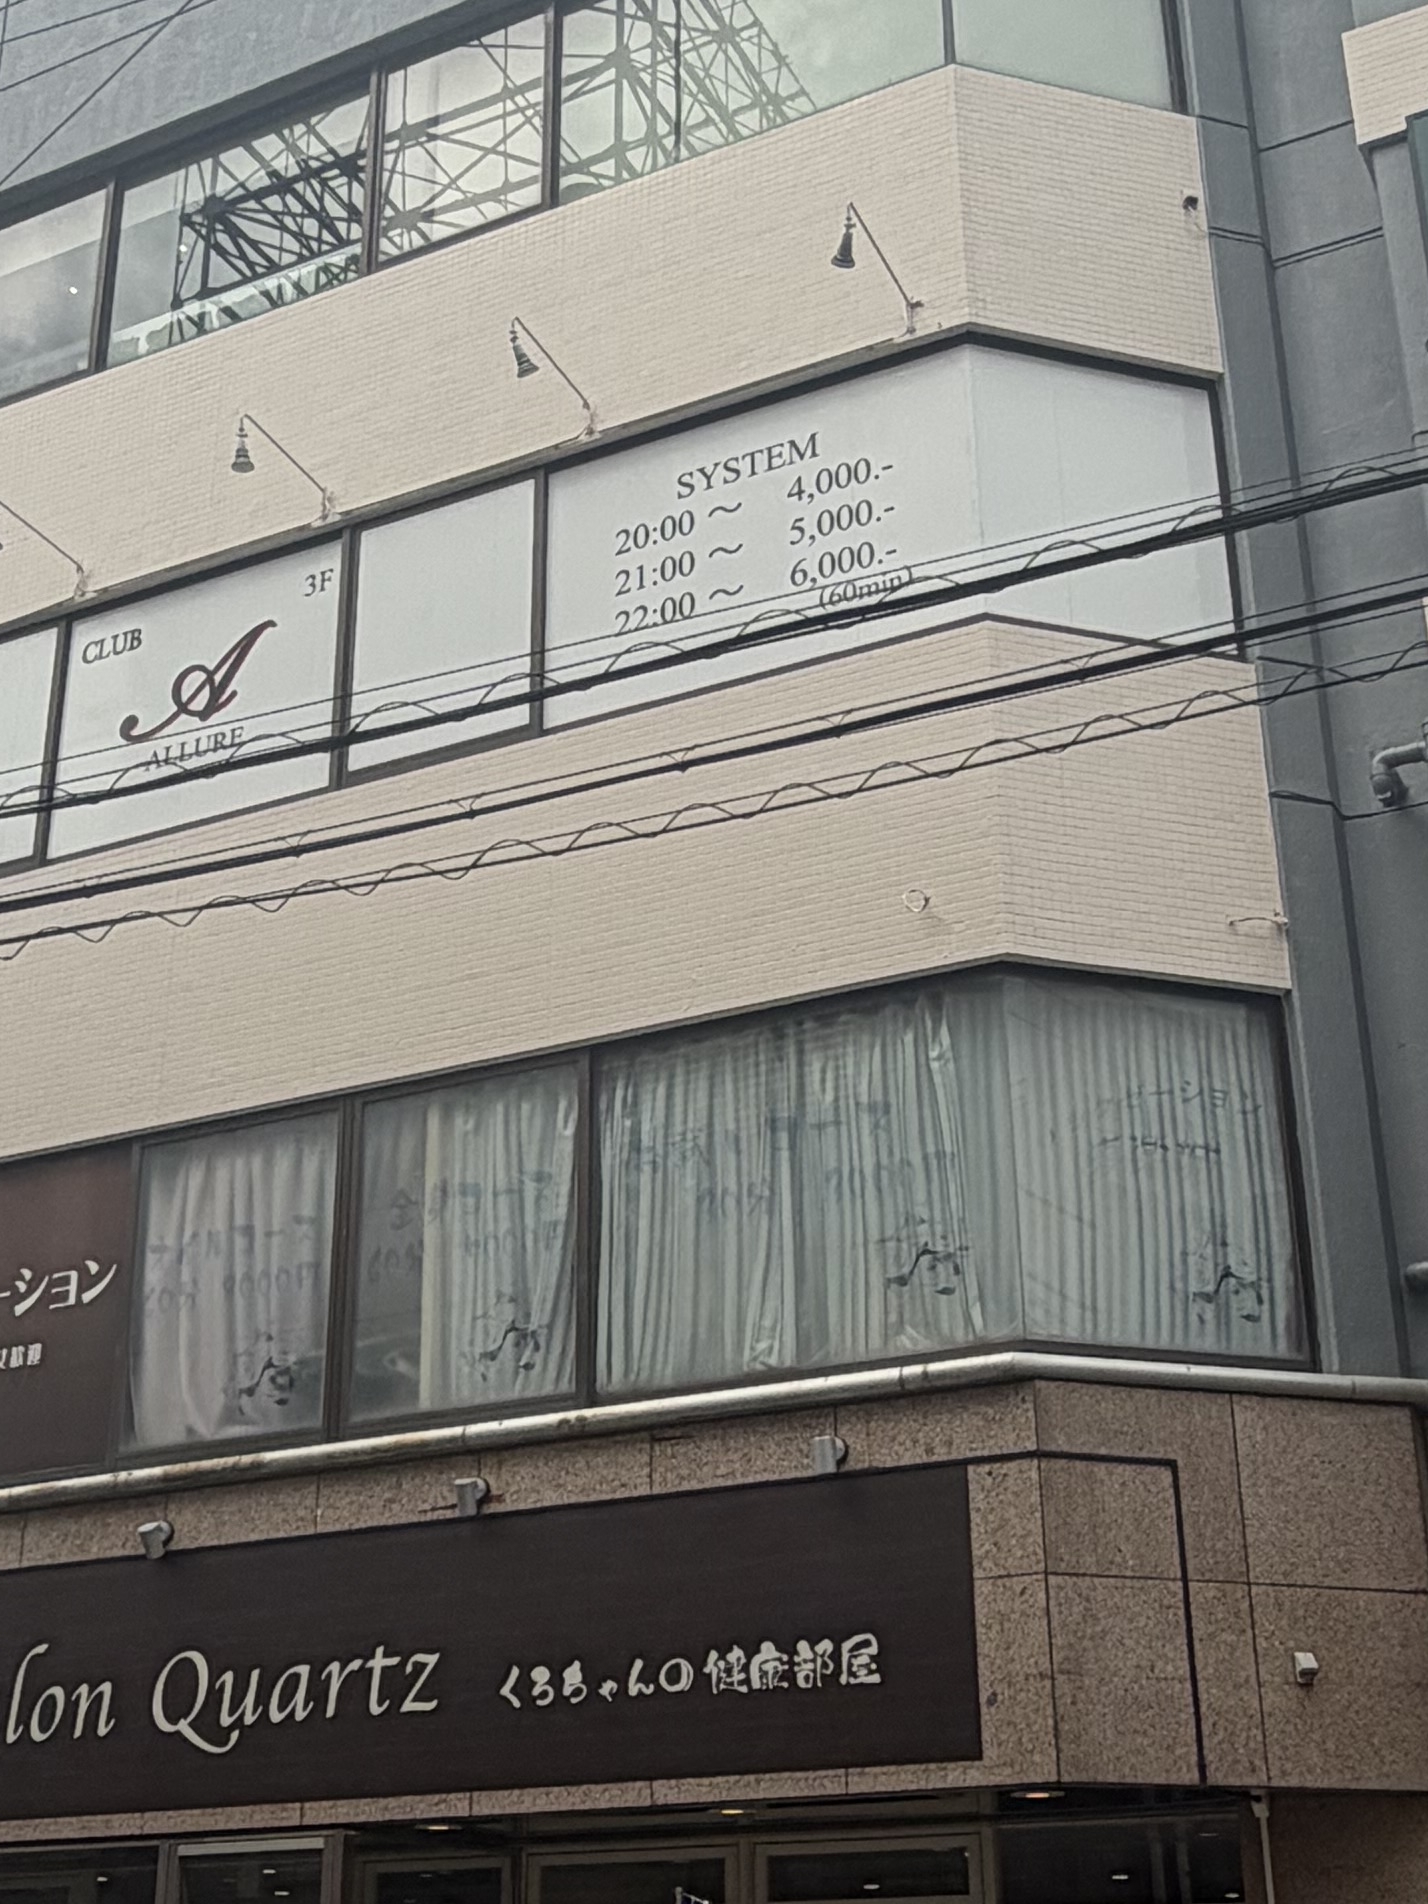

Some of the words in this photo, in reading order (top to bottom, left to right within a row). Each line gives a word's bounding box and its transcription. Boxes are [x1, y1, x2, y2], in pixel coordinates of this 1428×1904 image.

[677, 432, 821, 500] SYSTEM
[615, 509, 695, 556] 20:00
[303, 568, 335, 598] 3F
[615, 550, 695, 596] 21:00
[819, 565, 913, 611] (60min)
[615, 592, 696, 637] 22:00
[81, 628, 143, 665] CLUB
[144, 726, 245, 773] ALLURE
[499, 1632, 882, 1709] くろちゃんの健康部屋
[152, 1643, 441, 1754] Quartz
